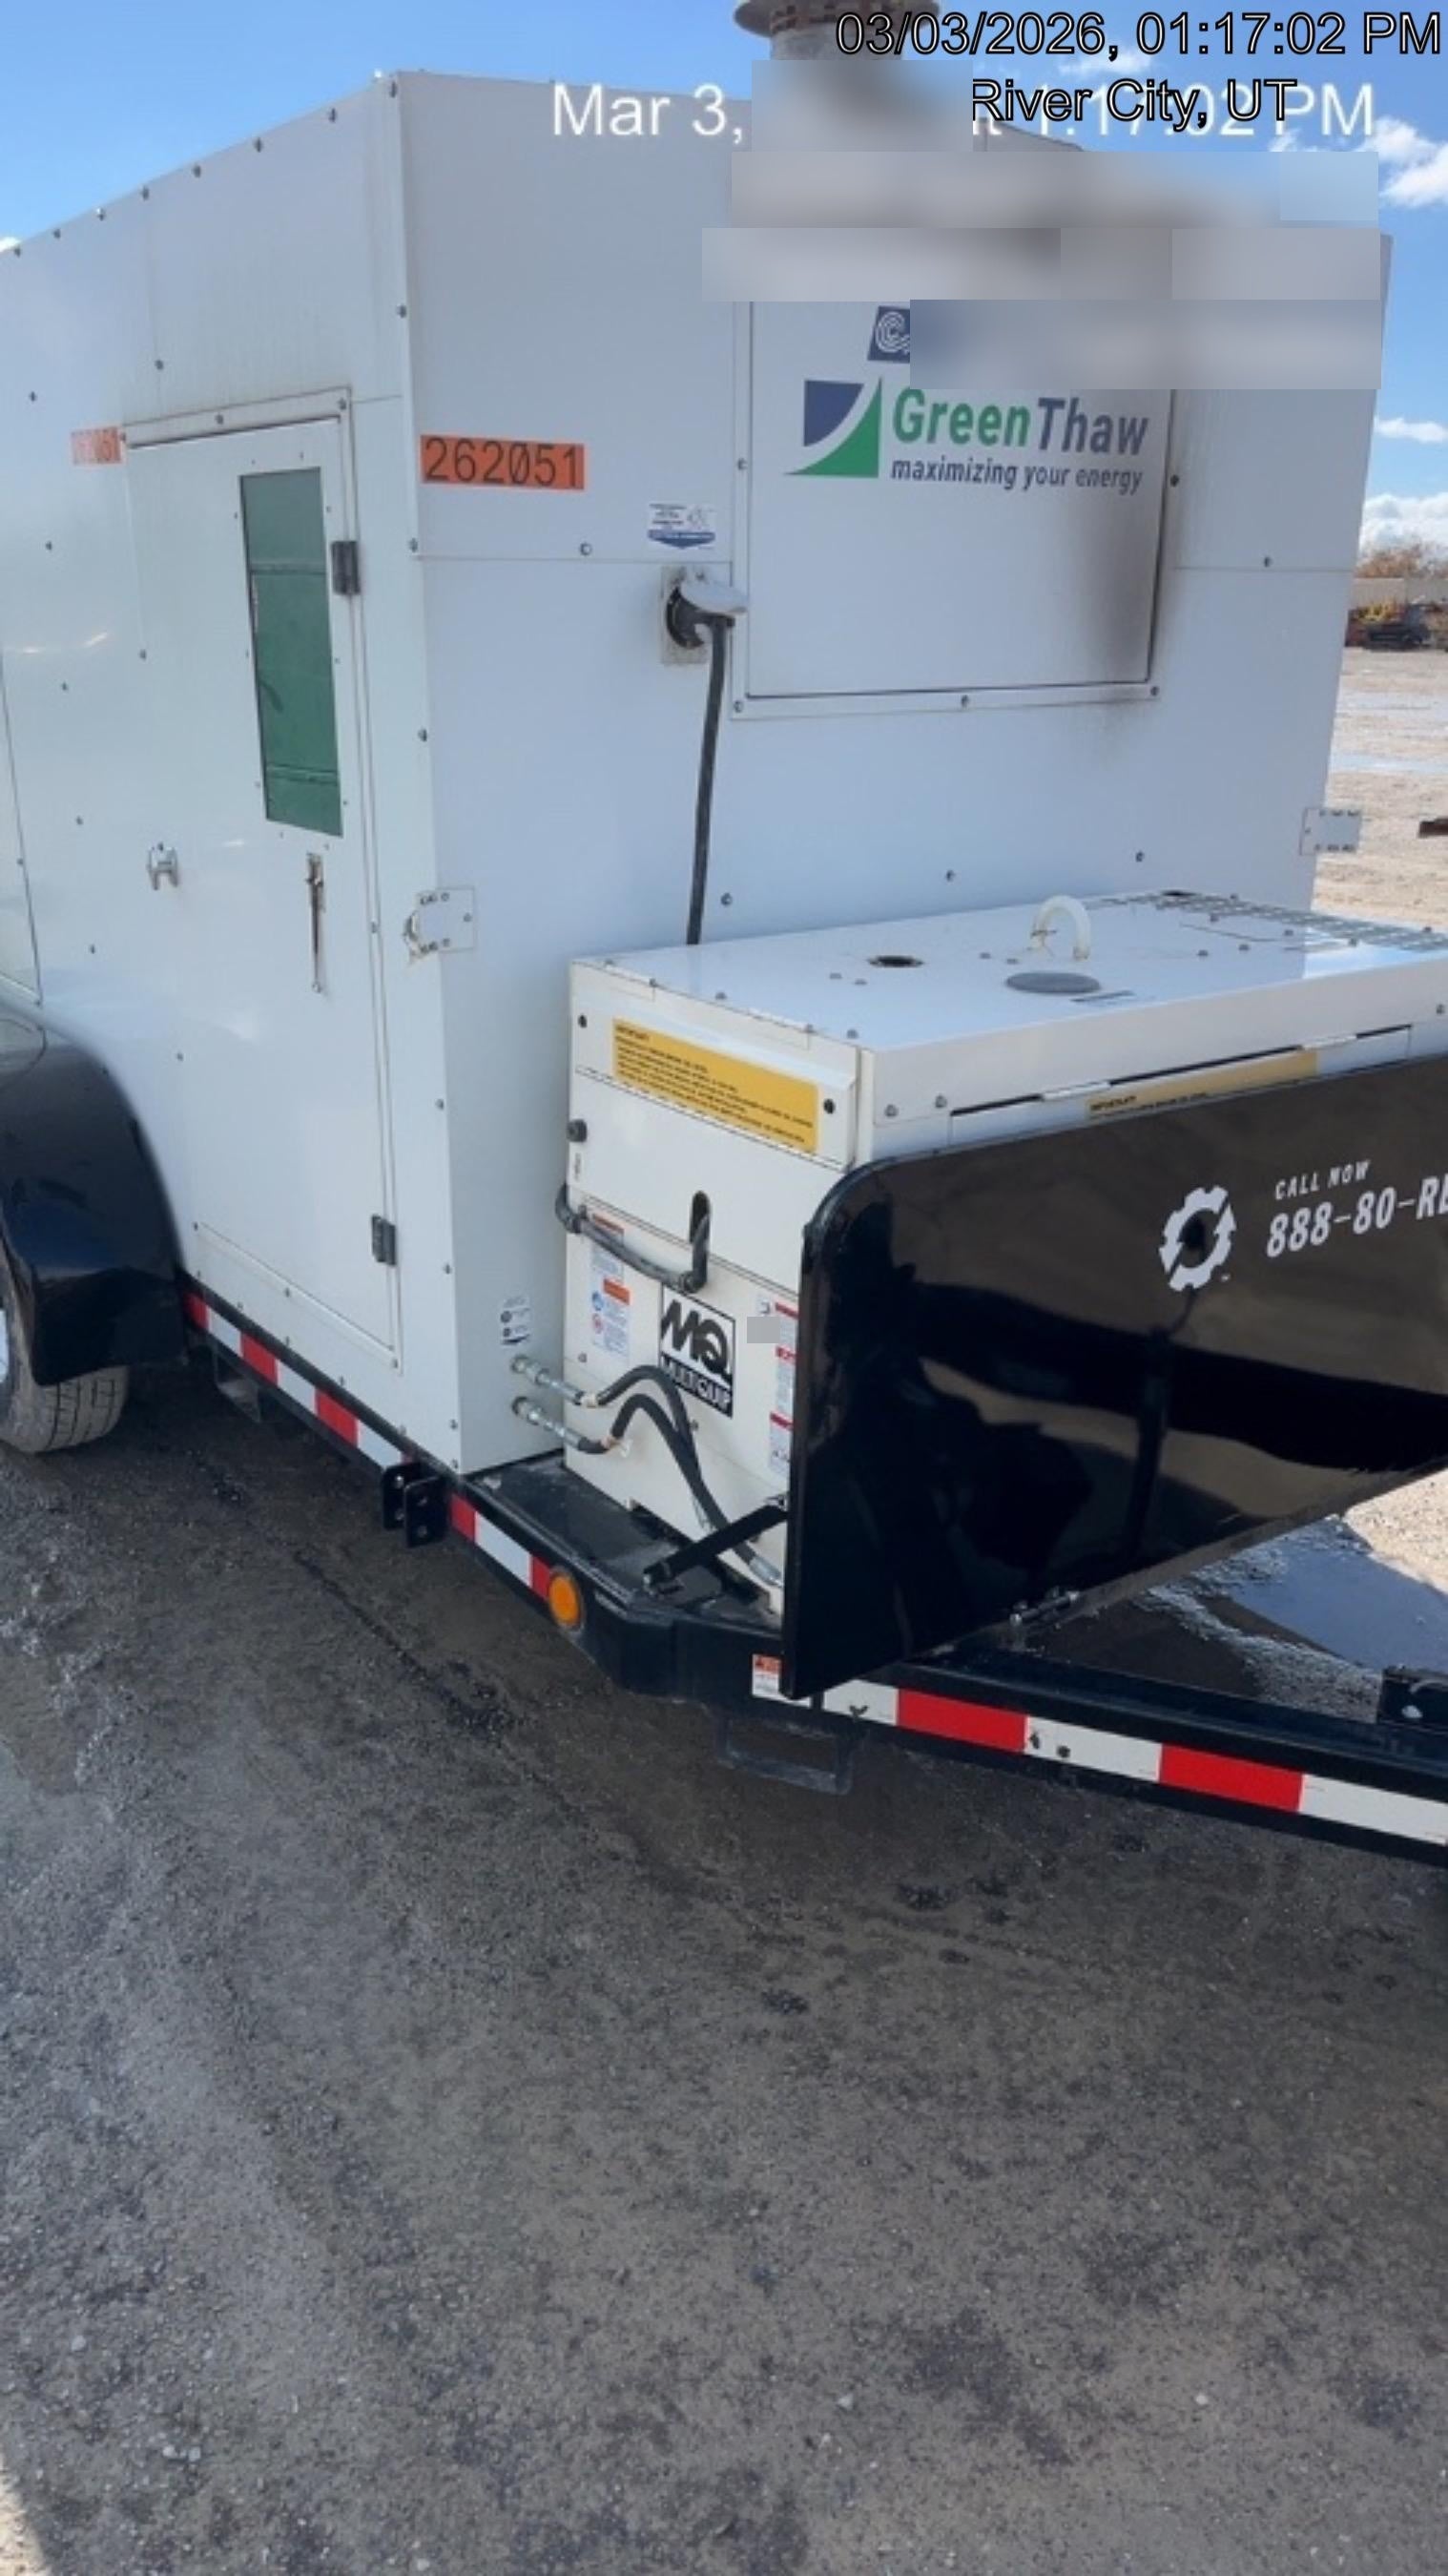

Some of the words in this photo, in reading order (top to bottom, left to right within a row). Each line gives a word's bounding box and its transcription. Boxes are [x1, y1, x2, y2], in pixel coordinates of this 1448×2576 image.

[892, 385, 1149, 456] GreenThaw
[425, 436, 576, 488] 262051
[891, 455, 1019, 490] maximizing
[1023, 463, 1071, 491] your
[1074, 467, 1144, 496] energy
[1274, 1172, 1319, 1201] CALL
[1327, 1159, 1372, 1189] NOW
